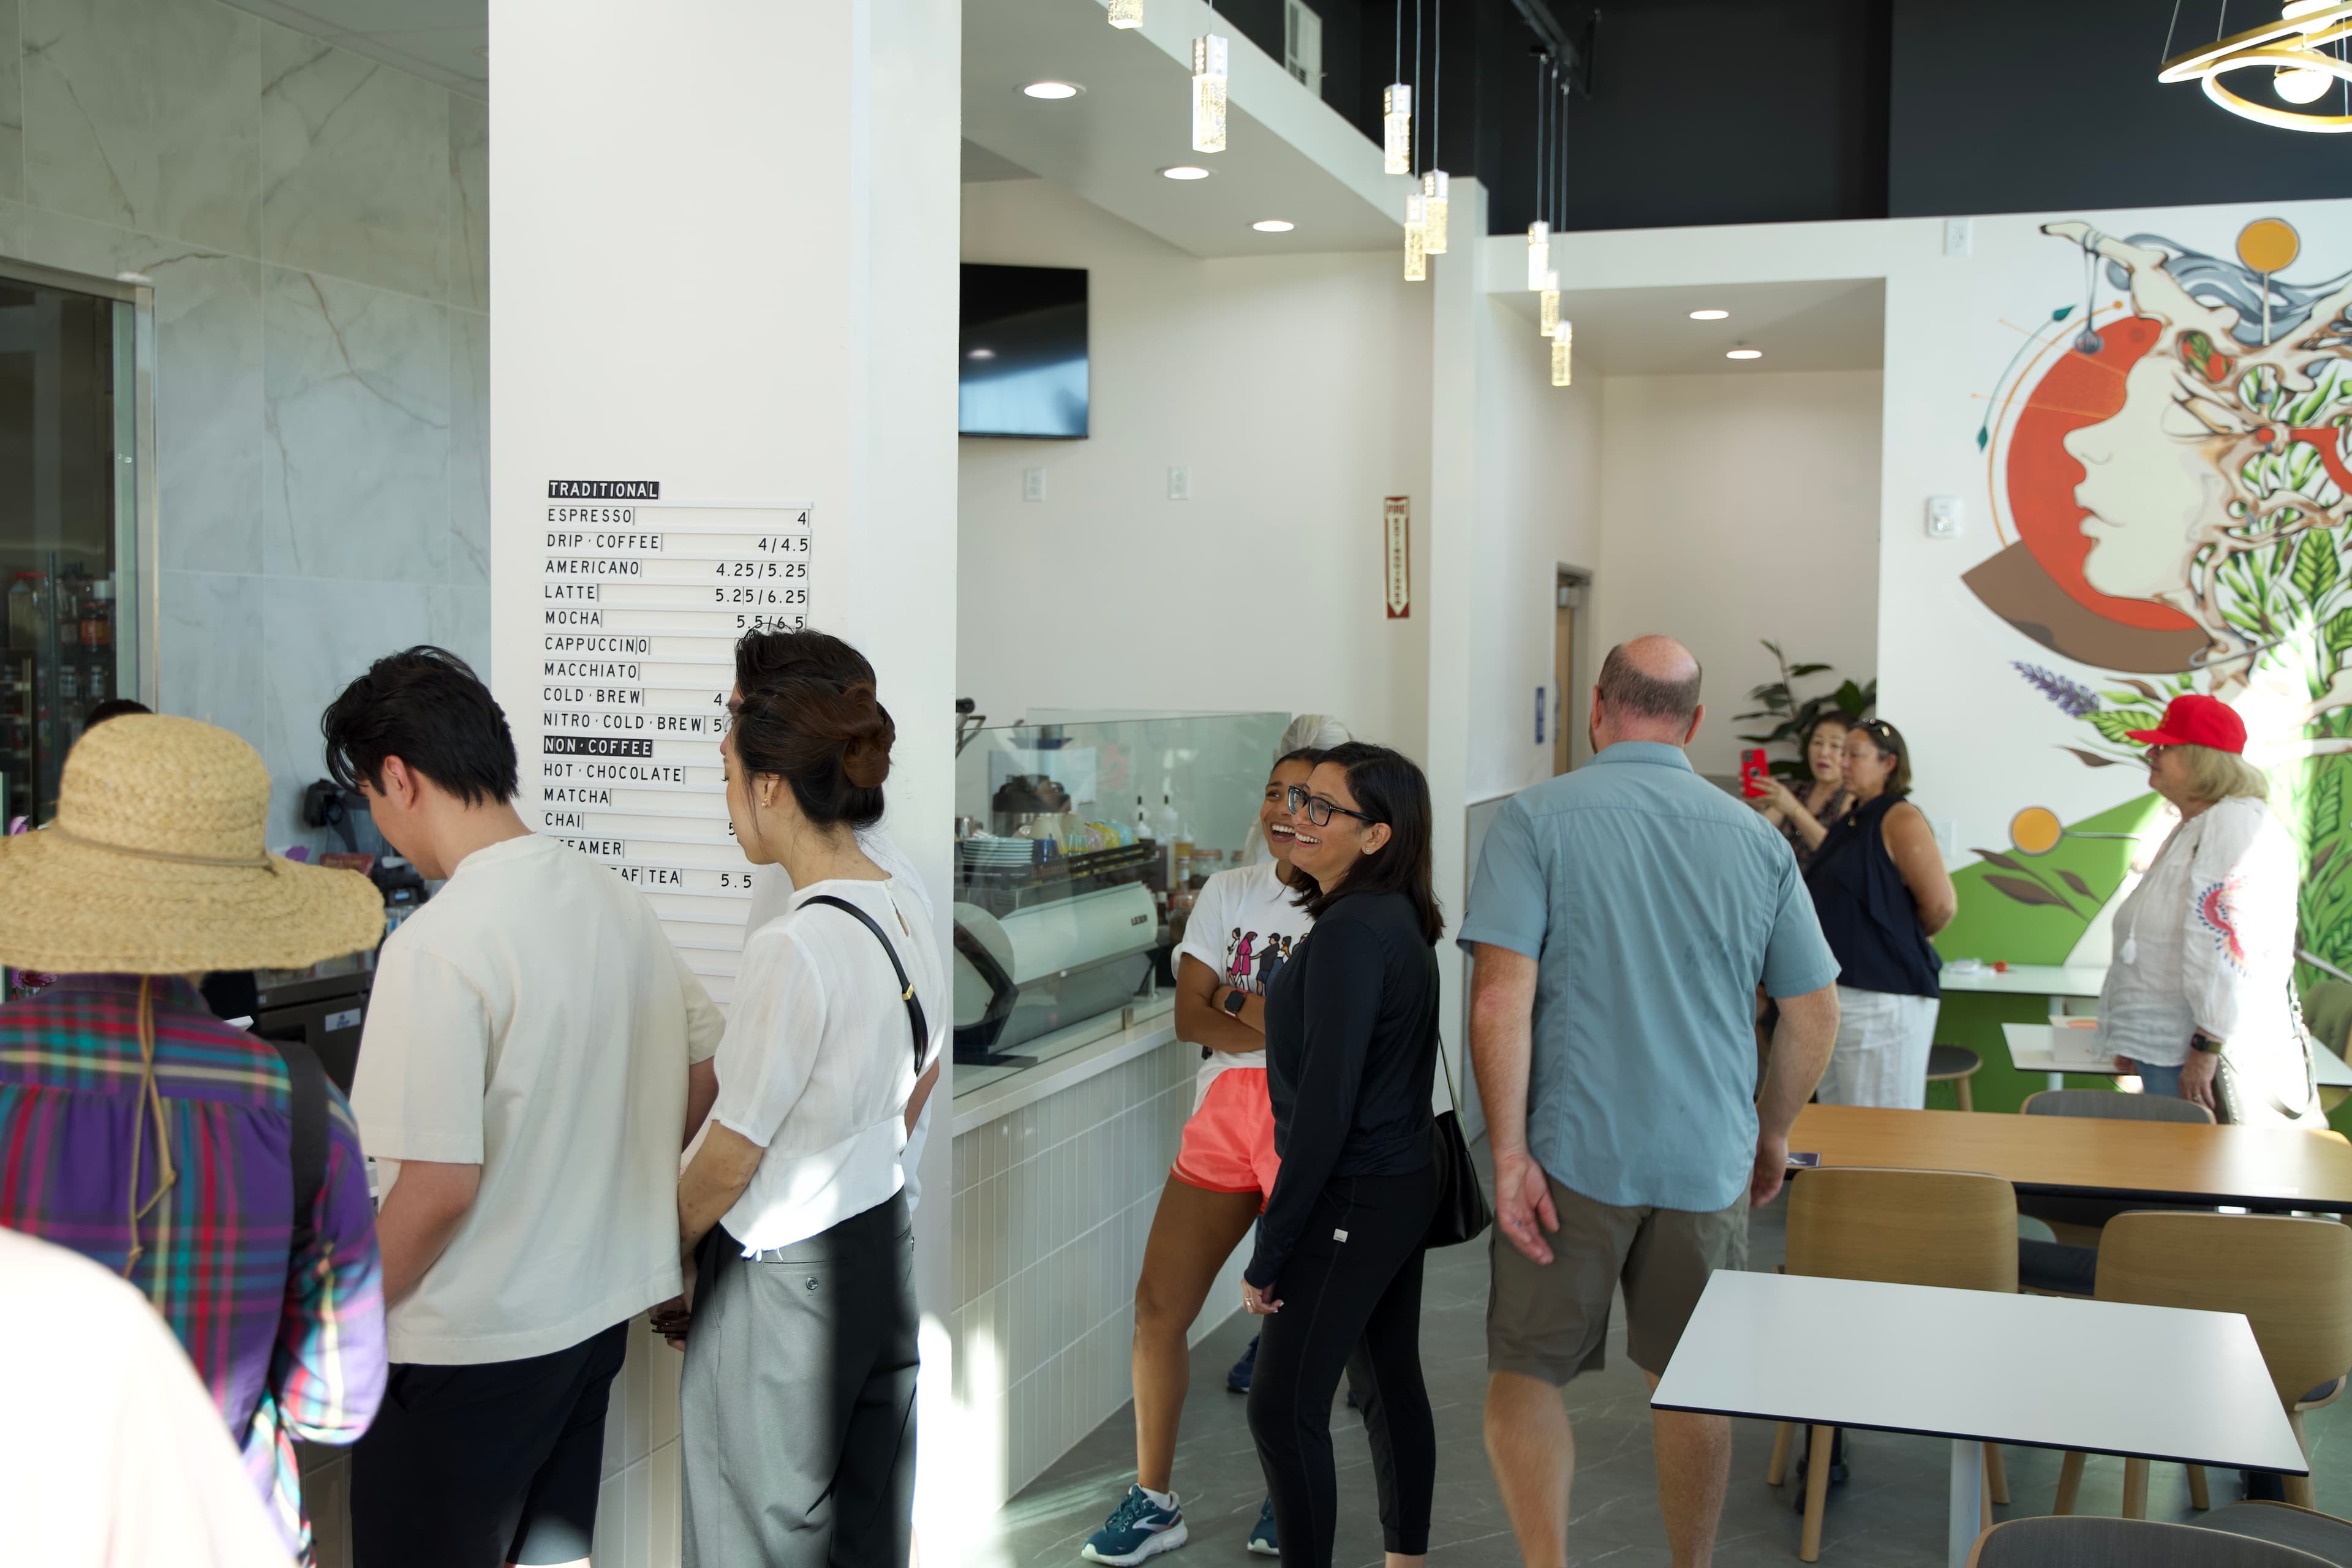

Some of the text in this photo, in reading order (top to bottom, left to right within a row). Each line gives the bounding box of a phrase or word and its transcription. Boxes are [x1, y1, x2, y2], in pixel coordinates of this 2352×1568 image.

[550, 482, 657, 497] TRADITIONAL
[548, 508, 807, 526] ESPRESSO 4
[758, 537, 808, 554] 4/4.5
[545, 560, 806, 579] AMERICANO 4.25/5.25
[545, 585, 805, 605] LATTE 5.25/6.25
[545, 611, 804, 631] MOCHA 5.5/65
[545, 636, 647, 653] CAPPUCCINO
[545, 662, 636, 679] MACCHIATO
[544, 788, 608, 804] MATCHA
[545, 812, 580, 827] CHAI
[649, 869, 679, 884] TEA
[721, 873, 752, 888] 5.5
